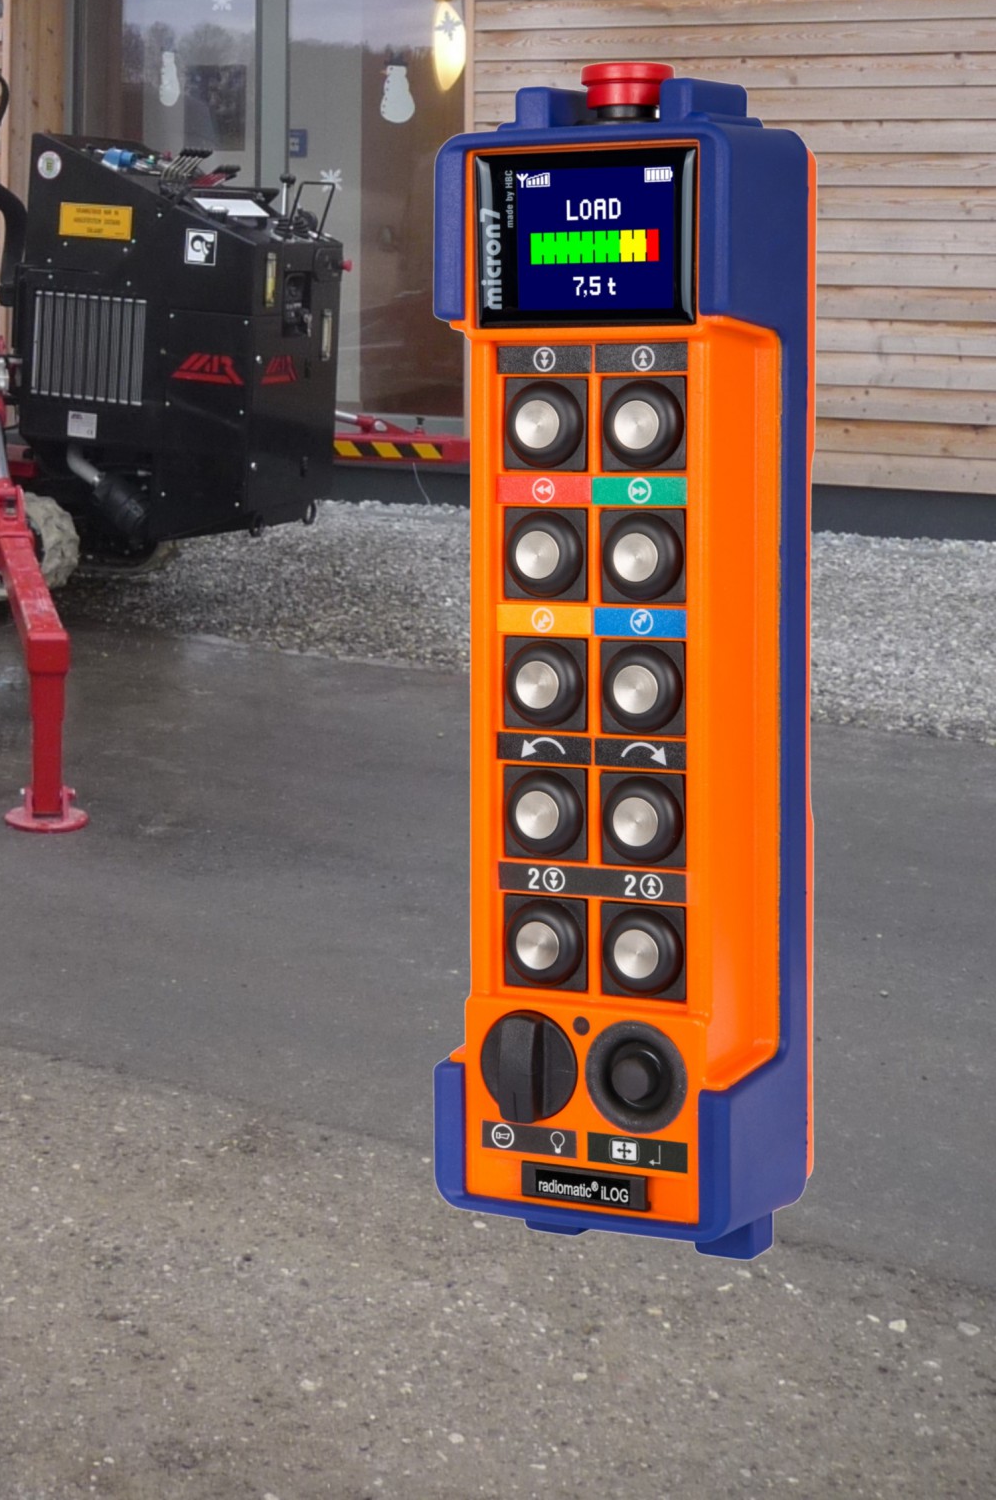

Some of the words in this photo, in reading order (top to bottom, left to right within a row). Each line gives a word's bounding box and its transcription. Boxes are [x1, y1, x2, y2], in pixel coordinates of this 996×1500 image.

[504, 170, 513, 189] HBC
[505, 190, 515, 202] by
[506, 204, 514, 228] made
[566, 197, 622, 221] LOAD
[480, 208, 502, 309] micron7
[572, 276, 602, 298] 7,5
[607, 277, 617, 296] t
[527, 868, 540, 890] 2
[623, 874, 637, 897] 2
[600, 1185, 629, 1203] iLOG
